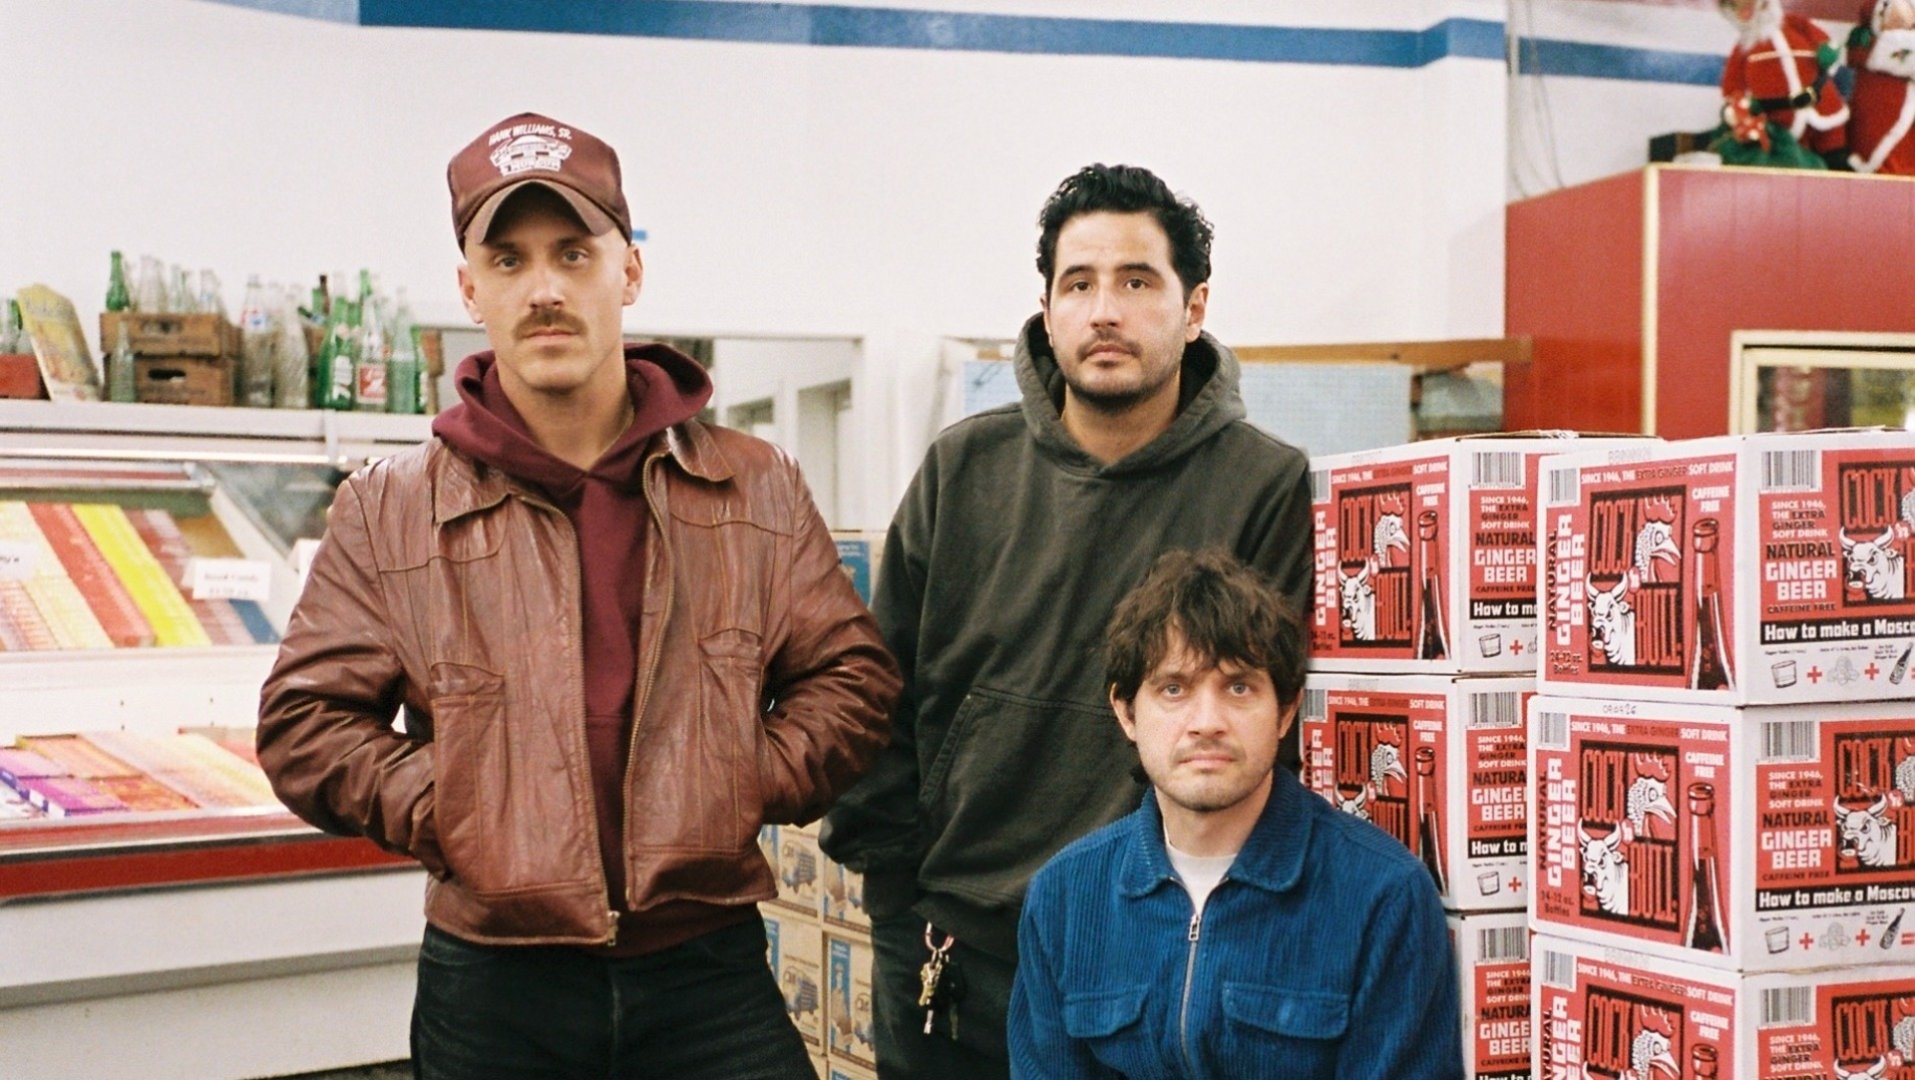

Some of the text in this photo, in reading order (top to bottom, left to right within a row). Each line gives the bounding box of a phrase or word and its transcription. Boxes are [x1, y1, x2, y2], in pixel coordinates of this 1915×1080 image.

[1688, 463, 1707, 476] SOFT
[1709, 461, 1734, 473] DRINK
[1481, 496, 1504, 504] SINCE
[1772, 500, 1798, 510] SINCE
[1481, 505, 1496, 513] THE
[1772, 510, 1825, 519] THE EXTRA
[1481, 521, 1530, 529] SOFT DRINK
[1772, 521, 1815, 530] GINGER
[1475, 532, 1536, 546] NATURAL
[1772, 529, 1828, 539] SOFT DRINK
[1474, 548, 1536, 566] GINGER
[1766, 543, 1835, 559] NATURAL
[1315, 511, 1326, 626] GINGER
[1326, 527, 1336, 608] BEER
[1484, 566, 1527, 582] BEER
[1765, 560, 1837, 581] GINGER
[1547, 530, 1557, 631] NATURAL
[1556, 514, 1572, 646] GINGER
[1570, 534, 1584, 626] BEER
[1777, 580, 1827, 600] BEER
[1473, 601, 1502, 616] How
[1505, 601, 1519, 616] to
[1767, 603, 1836, 614] CAFFEINE FREE
[1764, 623, 1798, 641] How
[1801, 622, 1816, 638] to
[1820, 621, 1859, 637] make
[1862, 623, 1871, 636] a
[1478, 736, 1501, 744] SINCE
[1680, 728, 1700, 740] SOFT
[1701, 729, 1728, 741] DRINK
[1478, 744, 1494, 752] THE
[1478, 752, 1516, 760] GINGER
[1478, 760, 1498, 769] SOFT
[1322, 747, 1333, 805] EER
[1473, 770, 1526, 785] NATURA
[1768, 771, 1796, 780] SINCE
[1768, 780, 1822, 790] THE EXTRA
[1769, 790, 1811, 799] GINGER
[1768, 799, 1824, 809] SOFT DRINK
[1481, 804, 1524, 822] BEER
[1539, 771, 1547, 870] NATURAL
[1762, 811, 1830, 828] NATURAL
[1547, 758, 1562, 888] GINGER
[1561, 779, 1576, 870] BEER
[1471, 840, 1500, 855] How
[1503, 839, 1517, 853] to
[1761, 829, 1832, 850] GINGER
[1772, 849, 1821, 870] BEER
[1759, 891, 1792, 908] How
[1795, 890, 1811, 906] to
[1813, 888, 1851, 905] make
[1855, 890, 1864, 903] a
[1486, 971, 1509, 979] SINCE
[1487, 986, 1523, 995] GINGER
[1687, 986, 1706, 999] SOFT
[1486, 994, 1530, 1004] SOFT DRIN
[1481, 1005, 1531, 1020] NATURA
[1480, 1021, 1530, 1039] GINGE
[1552, 996, 1567, 1080] NGER
[1770, 1035, 1794, 1044] SINCE
[1489, 1037, 1531, 1055] BEER
[1567, 1019, 1581, 1080] EER
[1770, 1044, 1819, 1053] THE EXTRA
[1770, 1054, 1810, 1064] GINGER
[1770, 1061, 1823, 1072] SOFT DRINK
